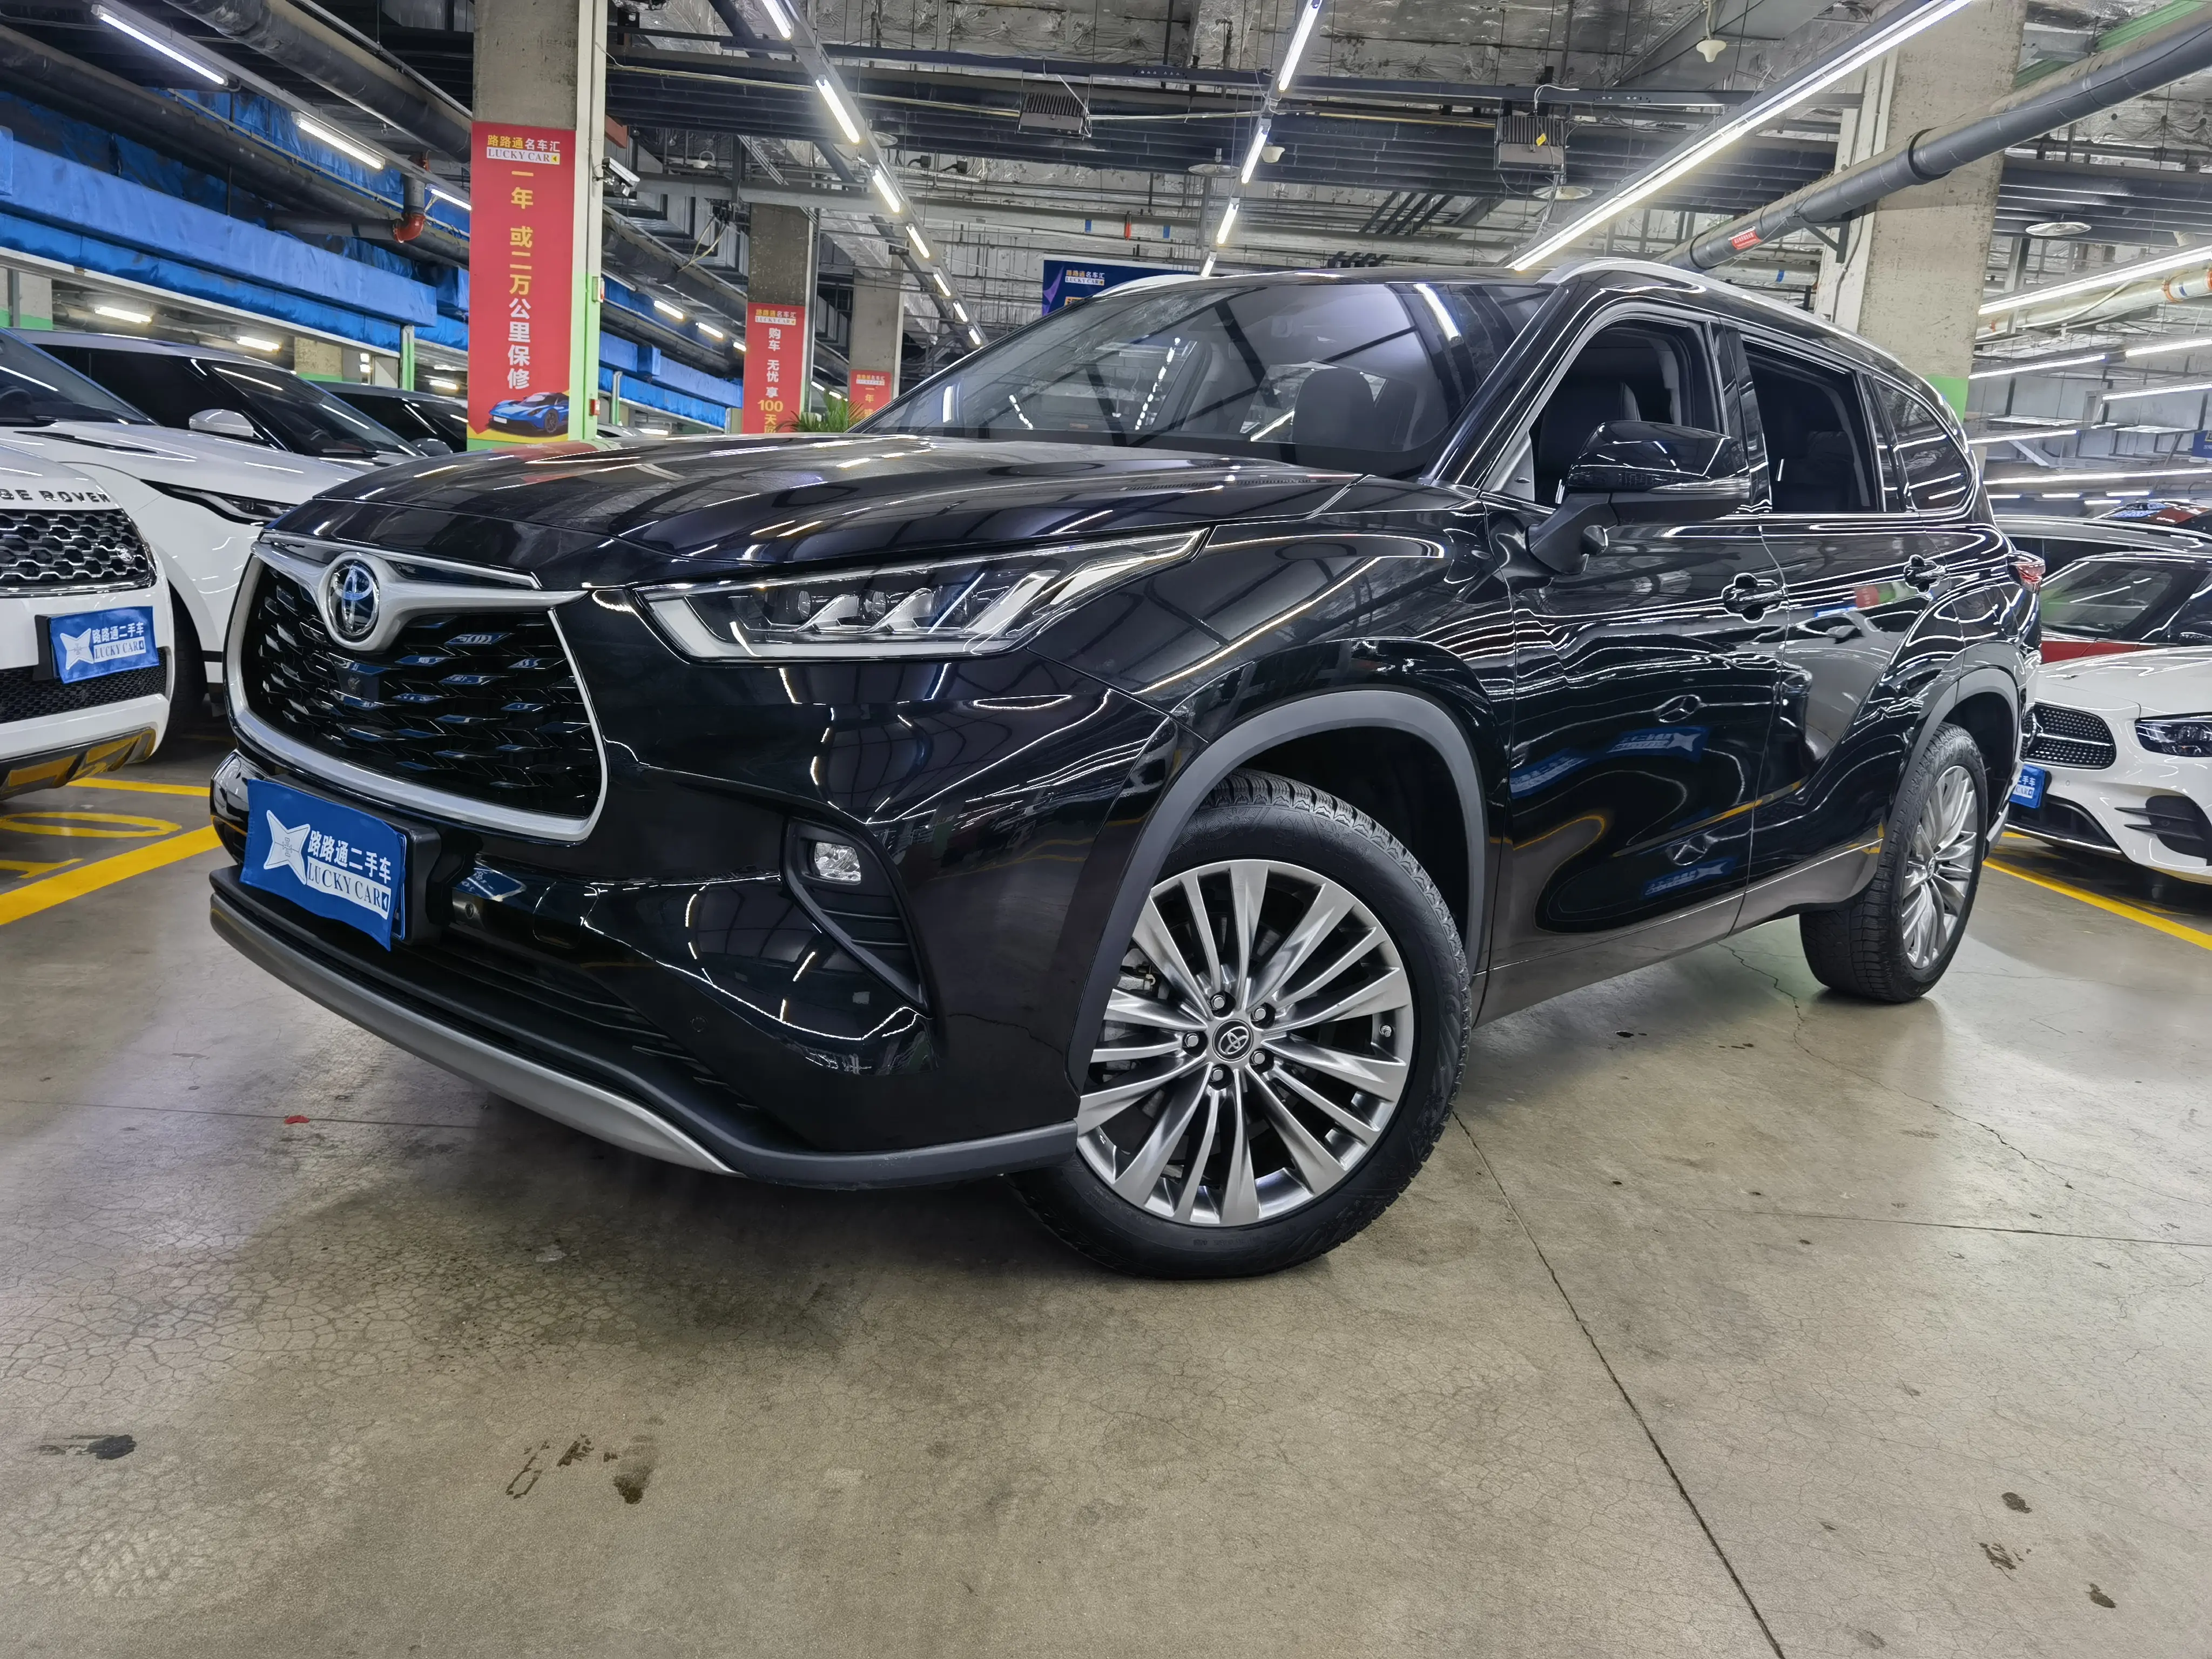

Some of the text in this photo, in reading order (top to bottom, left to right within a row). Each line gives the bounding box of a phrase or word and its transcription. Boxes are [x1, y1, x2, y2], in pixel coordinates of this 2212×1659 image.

[487, 135, 561, 152] 路路通名车汇
[488, 149, 550, 162] LUCKY CAR
[38, 490, 111, 503] ROVER
[92, 622, 144, 644] 路路通二手车
[95, 640, 138, 659] LUCKY CAR
[307, 830, 391, 884] 路路通二手车
[308, 862, 381, 908] LUCKY CAR
